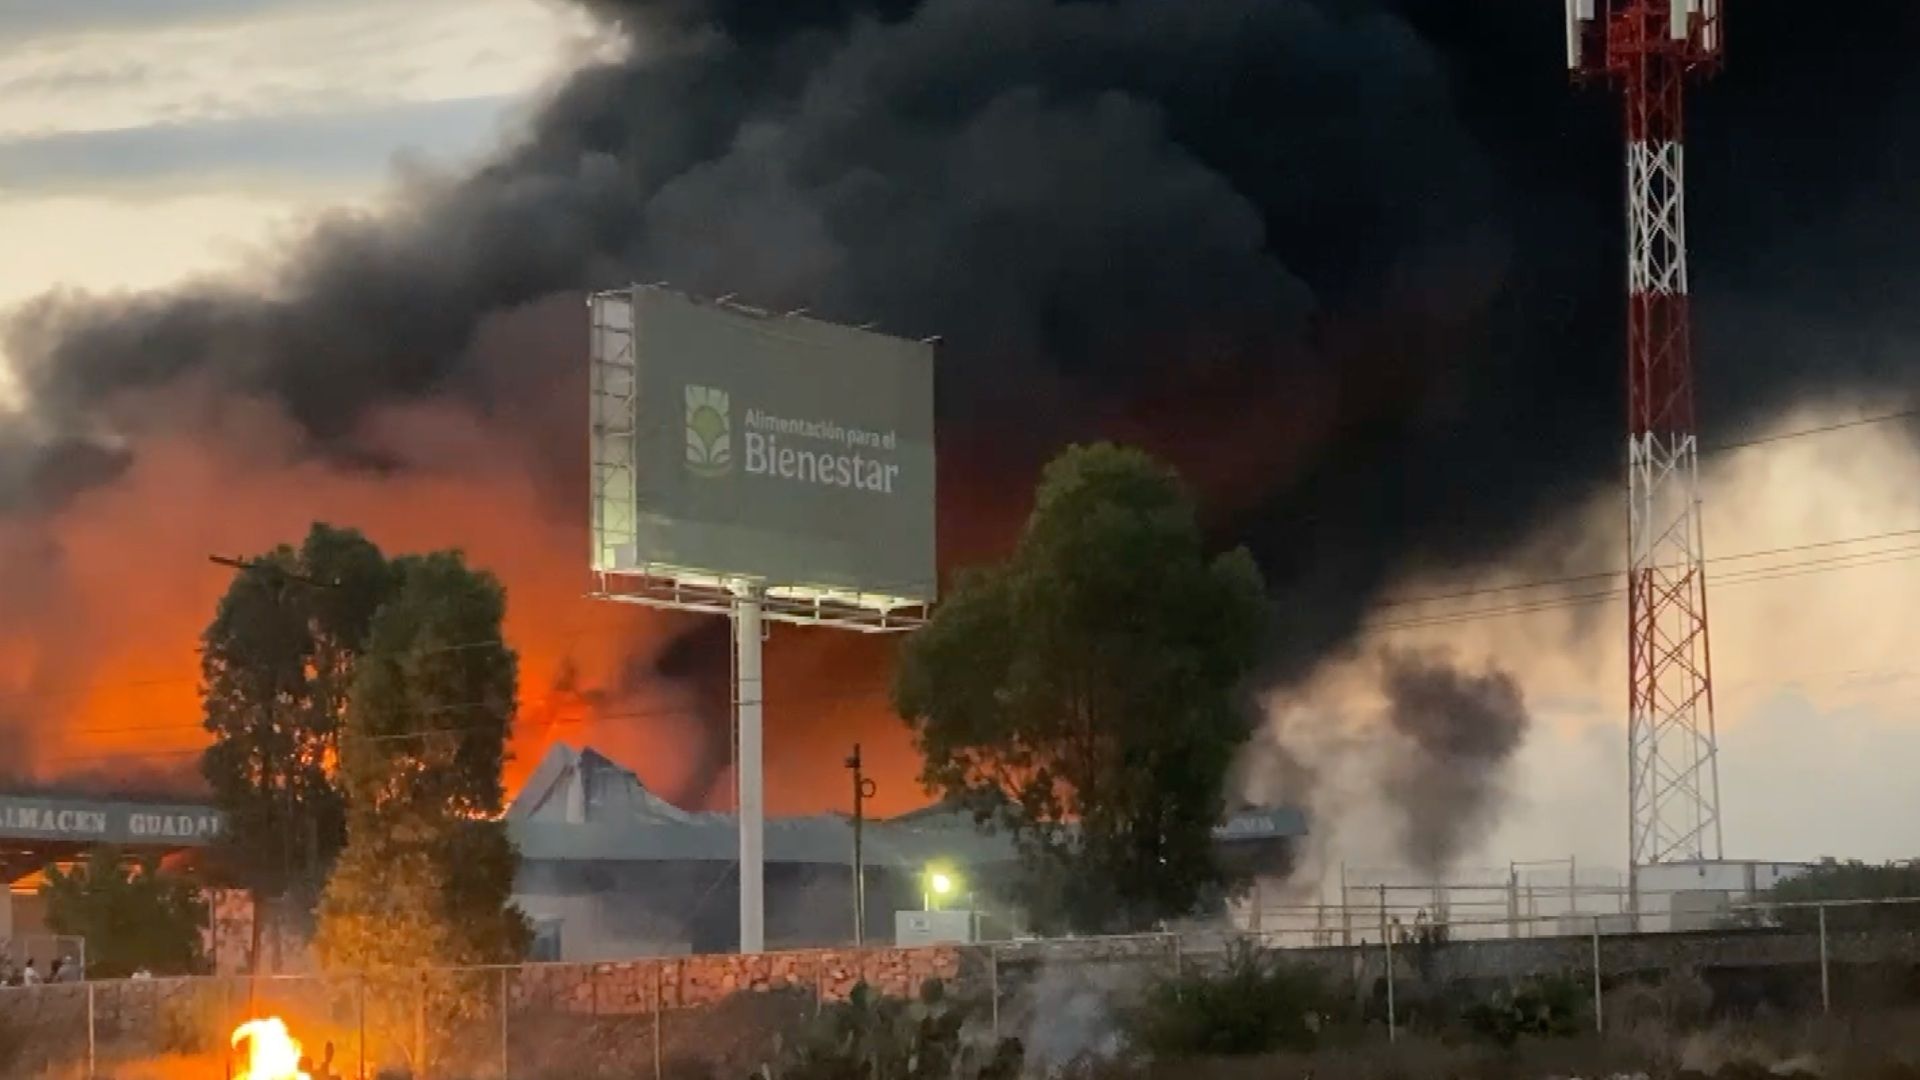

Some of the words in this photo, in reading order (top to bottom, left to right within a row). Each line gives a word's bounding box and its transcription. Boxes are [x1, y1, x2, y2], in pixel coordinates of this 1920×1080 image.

[745, 408, 844, 440] Alimentación
[847, 428, 880, 449] para
[882, 429, 896, 449] el
[745, 431, 899, 493] Bienestar
[0, 807, 106, 832] LMACEN
